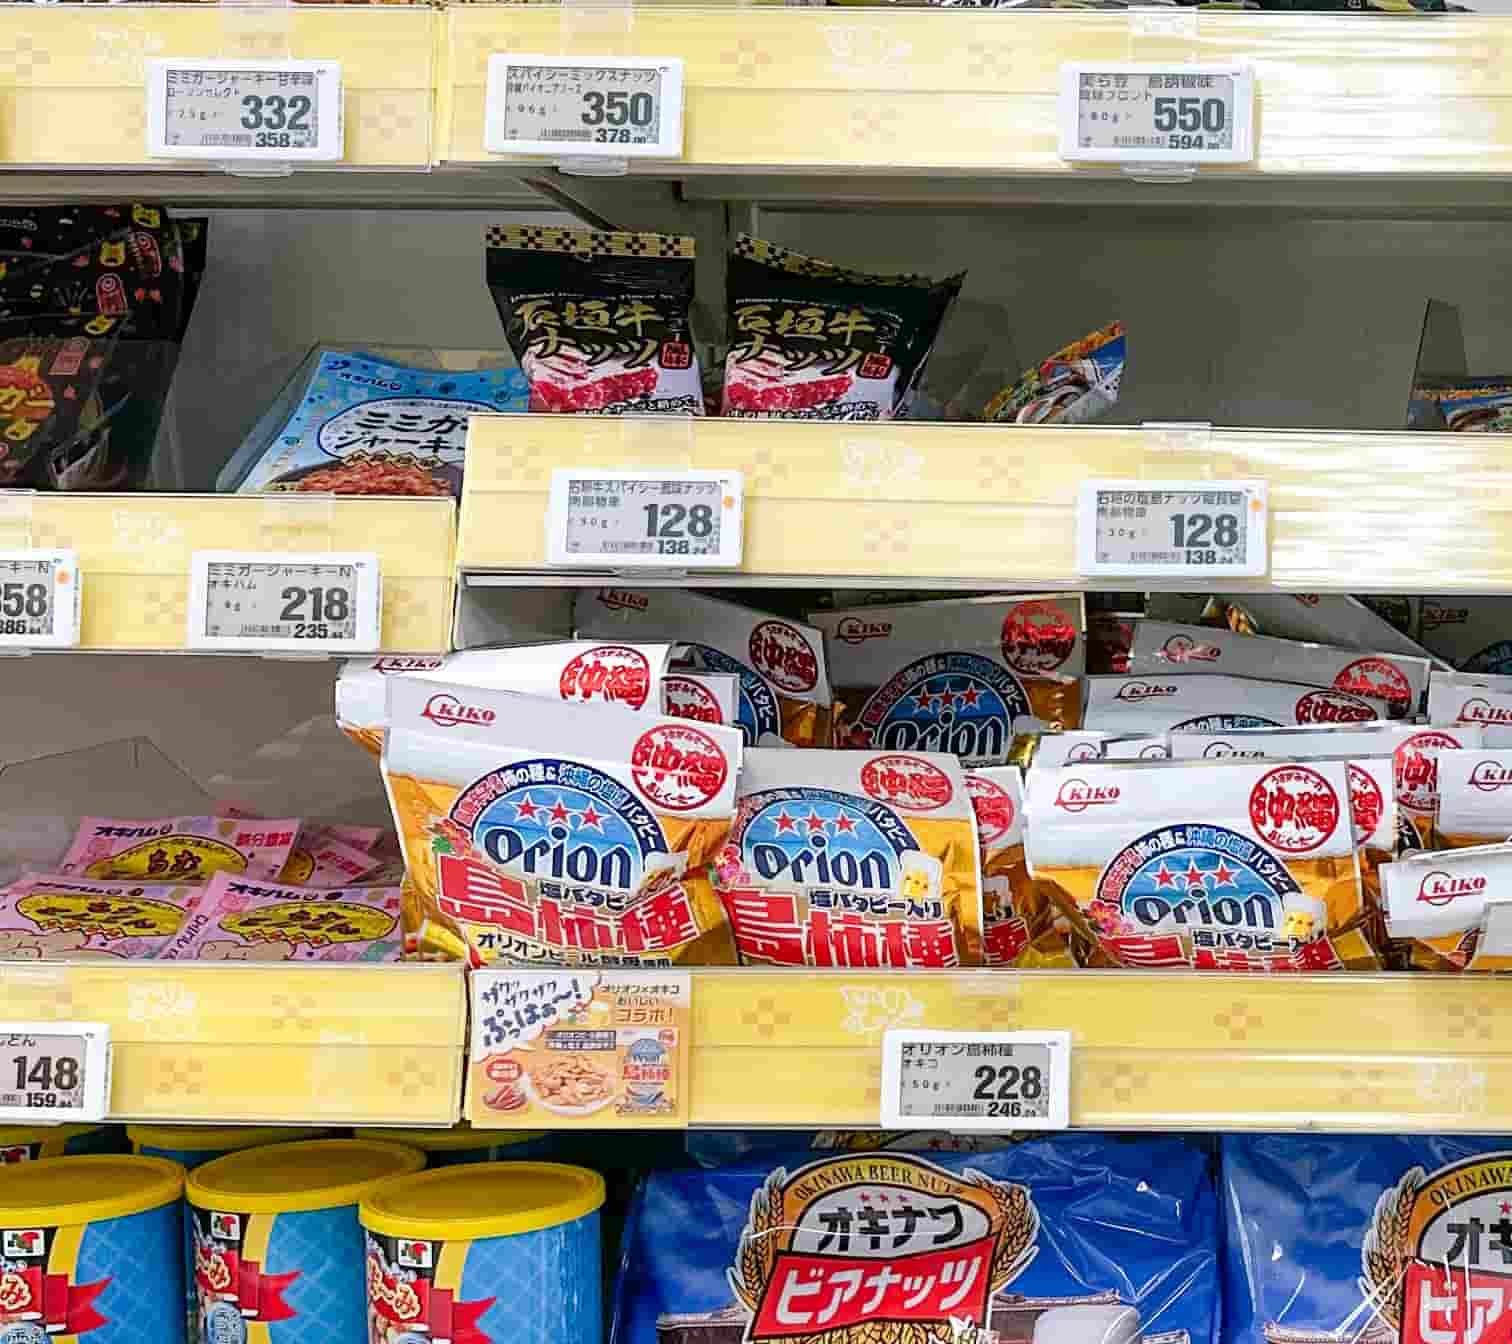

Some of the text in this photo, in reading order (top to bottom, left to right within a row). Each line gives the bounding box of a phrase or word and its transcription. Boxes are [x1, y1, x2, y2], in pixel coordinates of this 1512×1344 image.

[240, 94, 312, 131] 332
[581, 91, 654, 127] 350
[1153, 97, 1226, 133] 550
[514, 300, 660, 342] 石垣牛
[732, 303, 877, 348] 石垣牛
[526, 327, 660, 370] ナッツ
[739, 334, 865, 379] ナッツ
[642, 503, 713, 538] 128
[1169, 513, 1240, 548] 128
[279, 586, 350, 622] 218
[484, 824, 632, 889] Orion
[751, 834, 893, 890] Orion
[437, 856, 699, 953] 島柿種
[1132, 886, 1275, 929] Orion
[12, 1054, 79, 1091] 148
[973, 1064, 1042, 1100] 228
[868, 1163, 912, 1188] BEER
[818, 1203, 965, 1255] オキナワ
[775, 1256, 981, 1328] ビアナッツ
